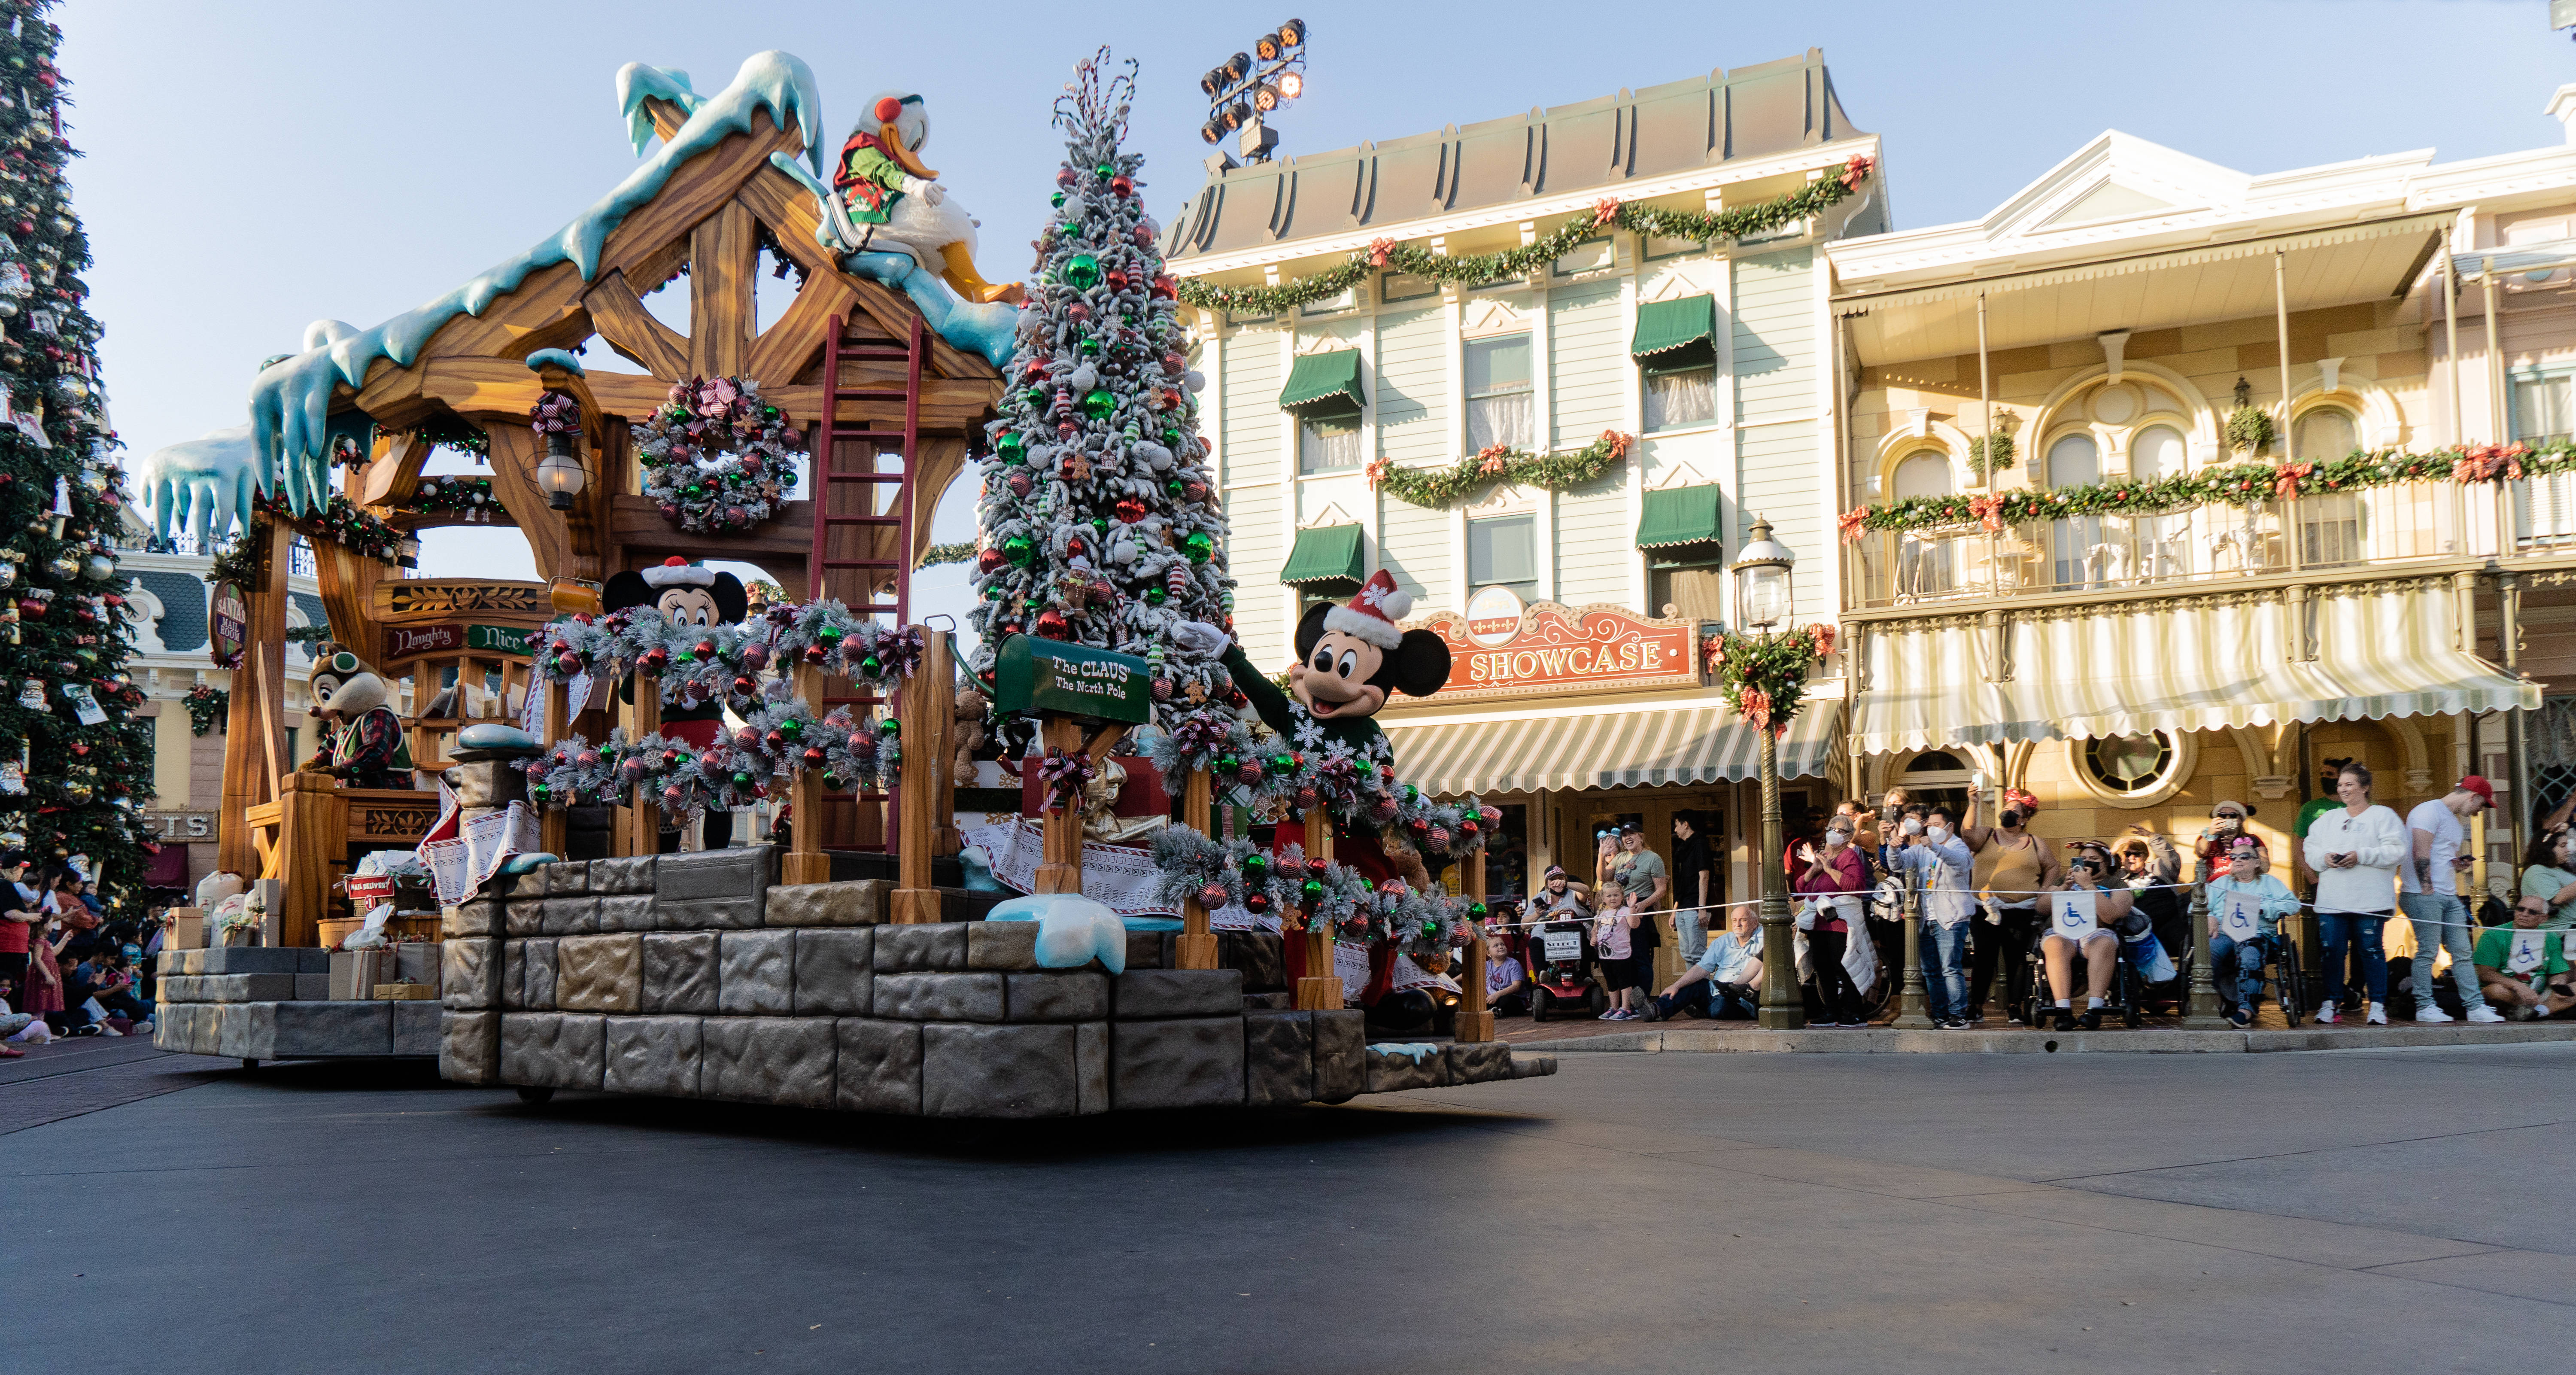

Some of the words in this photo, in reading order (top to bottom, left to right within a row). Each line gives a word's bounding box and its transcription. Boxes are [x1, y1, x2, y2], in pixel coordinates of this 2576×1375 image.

[218, 597, 246, 623] SANTA'S
[220, 625, 240, 642] ROOM
[222, 617, 239, 633] MAIL
[482, 626, 520, 650] Nice
[1053, 656, 1078, 675] The
[1081, 661, 1130, 683] CLAUS'
[1470, 642, 1663, 681] SHOWCASE
[1056, 676, 1074, 691] The
[1077, 681, 1104, 694] North
[1106, 683, 1126, 700] Pole
[1018, 861, 1030, 880] Richard
[350, 882, 363, 891] MAIL
[444, 876, 453, 894] Desiree
[1093, 882, 1102, 901] Randall
[1101, 884, 1112, 904] Kathryn
[1110, 890, 1119, 902] Ryan
[1118, 891, 1129, 905] Emily
[1127, 893, 1136, 907] Edwin
[1135, 888, 1145, 905] Bradley
[1344, 975, 1355, 994] Madison
